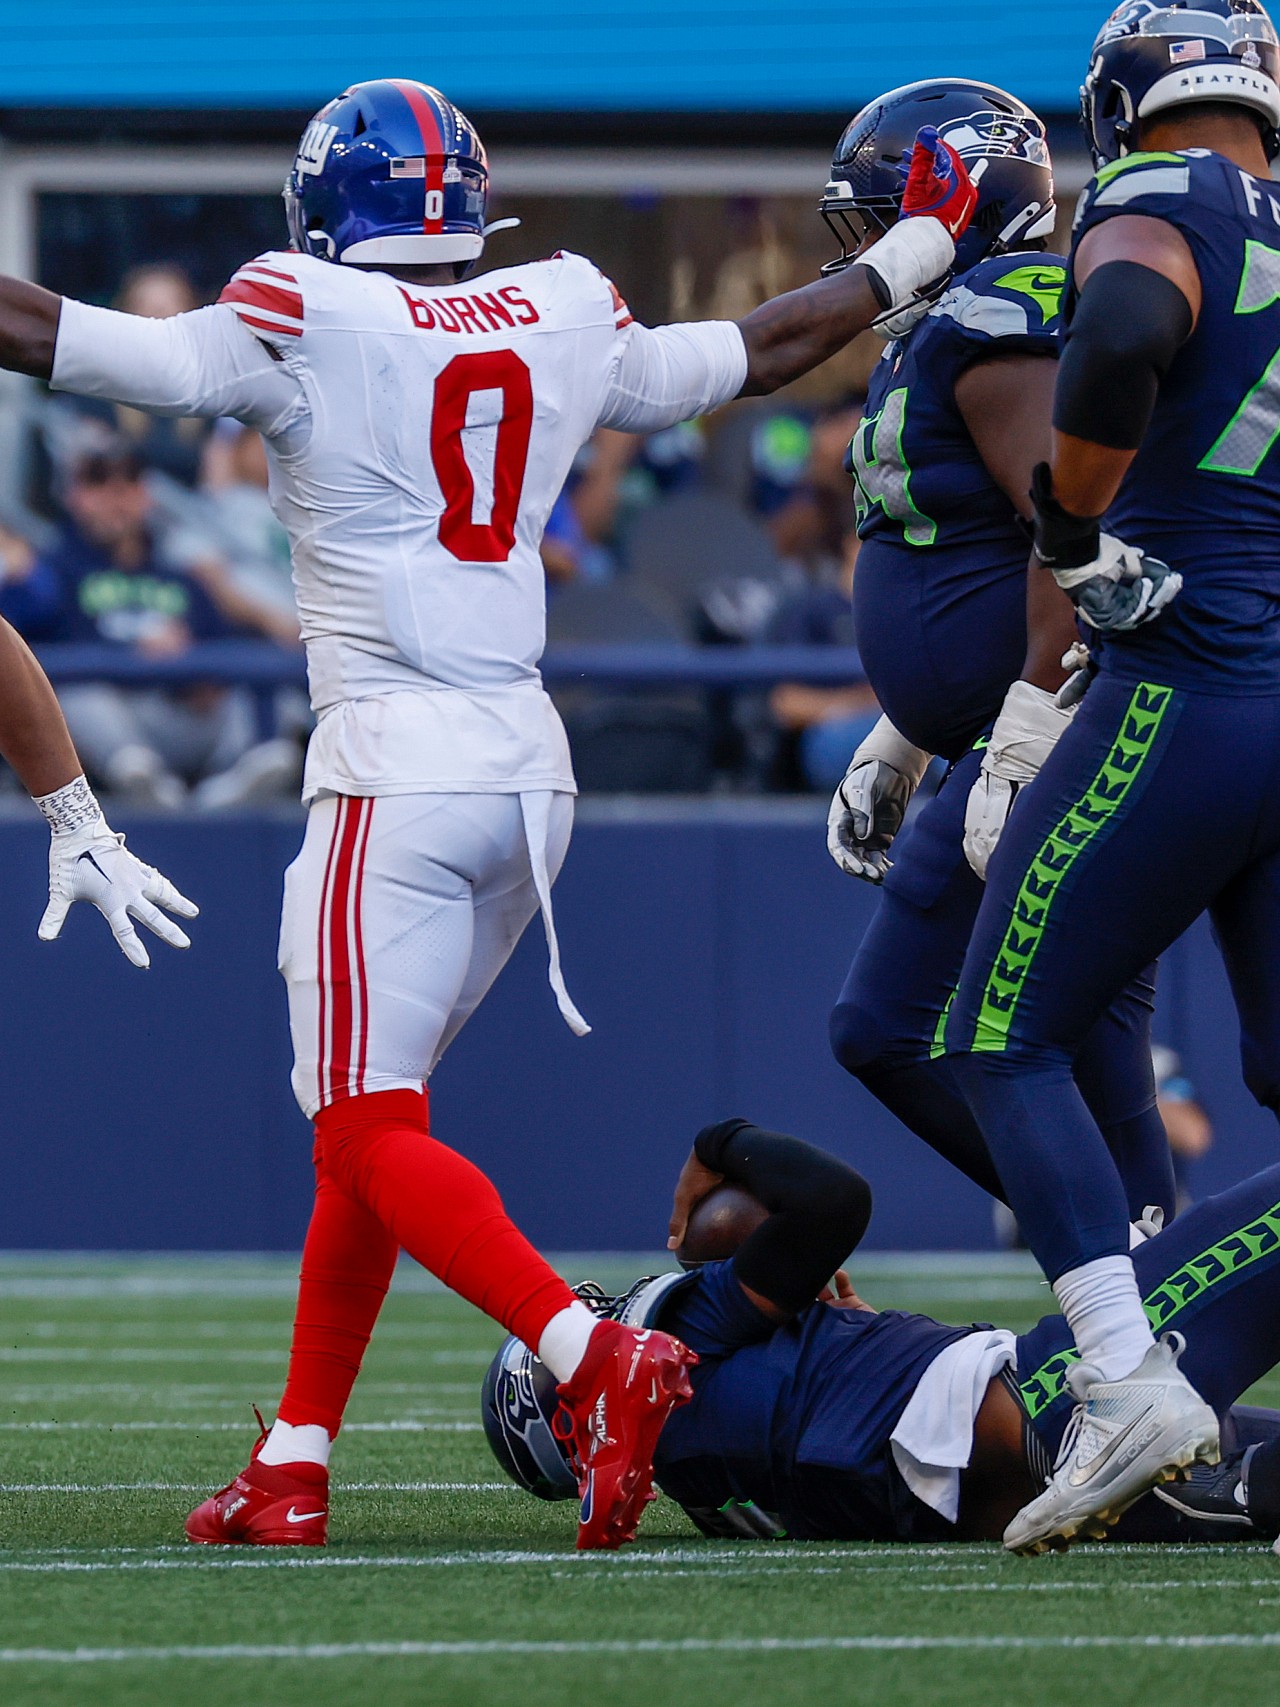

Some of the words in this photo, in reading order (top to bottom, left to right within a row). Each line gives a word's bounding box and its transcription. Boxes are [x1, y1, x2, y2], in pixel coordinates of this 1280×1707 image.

[1180, 74, 1269, 94] SEATTLE
[425, 190, 443, 220] 0
[430, 348, 534, 562] 0
